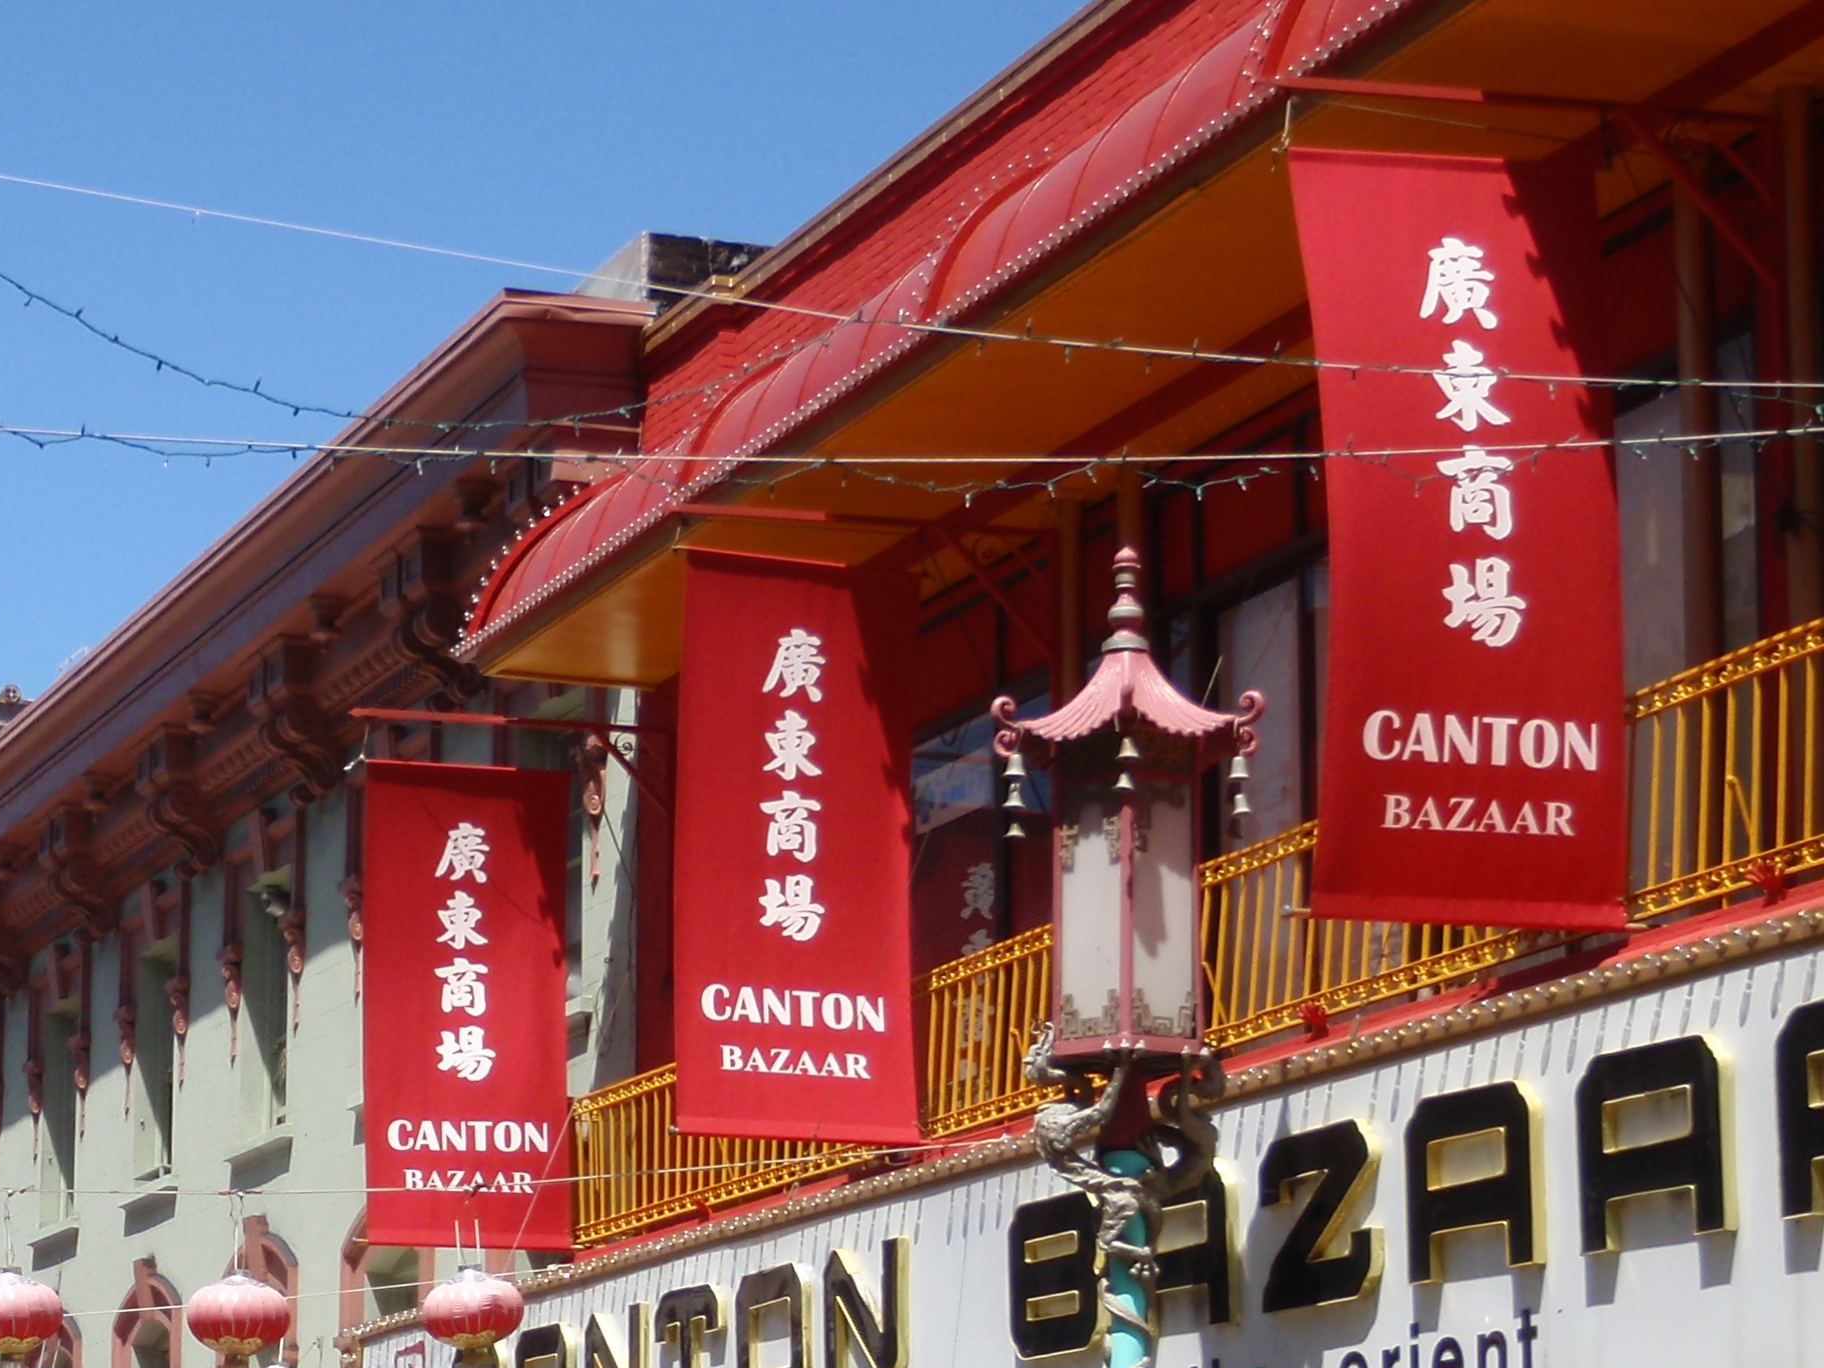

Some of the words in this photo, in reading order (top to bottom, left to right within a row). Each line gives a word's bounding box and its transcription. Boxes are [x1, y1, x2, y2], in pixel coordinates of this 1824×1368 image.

[1420, 236, 1526, 648] 廣東商場
[1362, 709, 1598, 772] CANTON
[758, 628, 827, 941] 廣東商場
[1381, 794, 1575, 837] BAZAAR
[435, 821, 496, 1082] 廣東商場
[700, 981, 886, 1033] CANTON
[719, 1043, 871, 1080] BAZAAR
[386, 1118, 549, 1154] CANTON
[402, 1169, 533, 1194] BAZAAR
